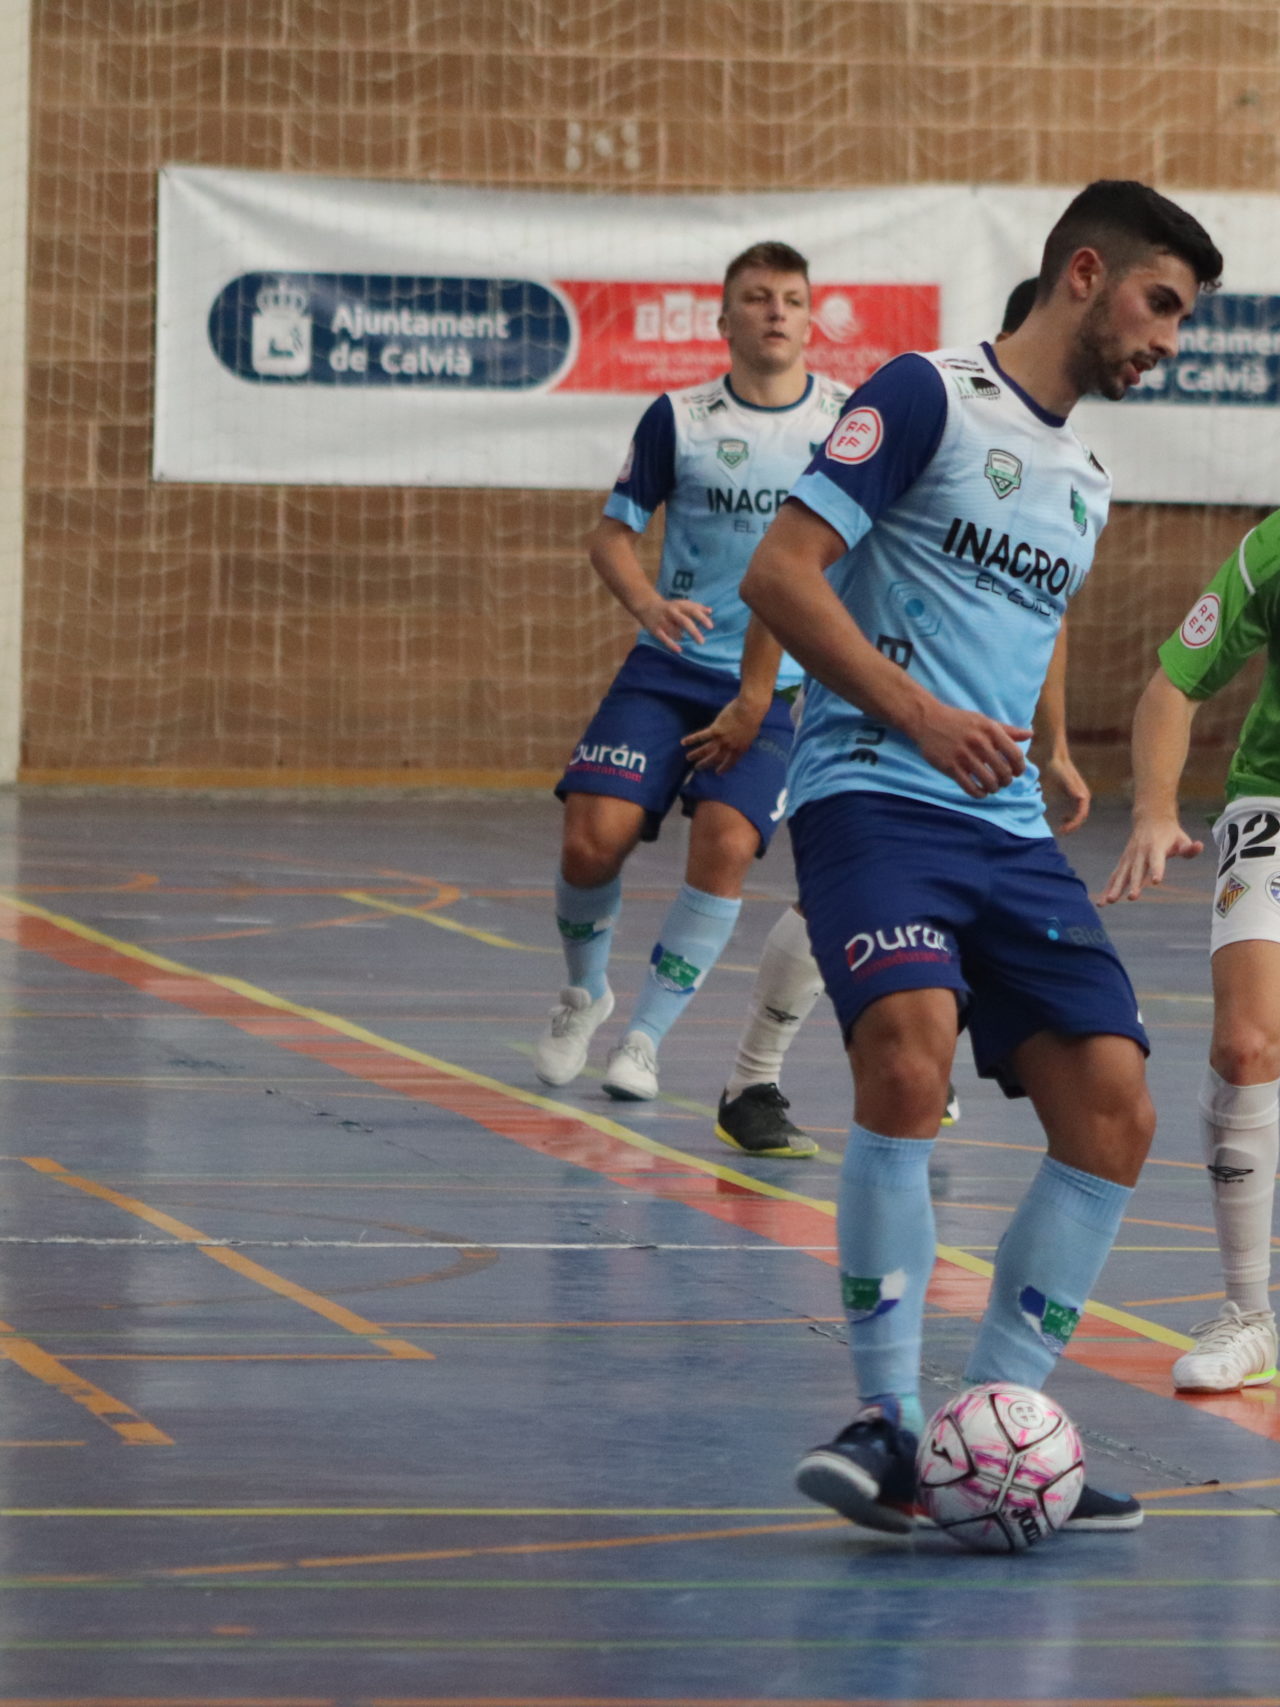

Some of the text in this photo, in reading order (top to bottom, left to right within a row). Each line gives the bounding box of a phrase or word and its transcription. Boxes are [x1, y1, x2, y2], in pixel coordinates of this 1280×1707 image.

[331, 305, 508, 339] Ajuntament
[329, 344, 472, 376] de Calvià
[1177, 364, 1269, 393] Calvià
